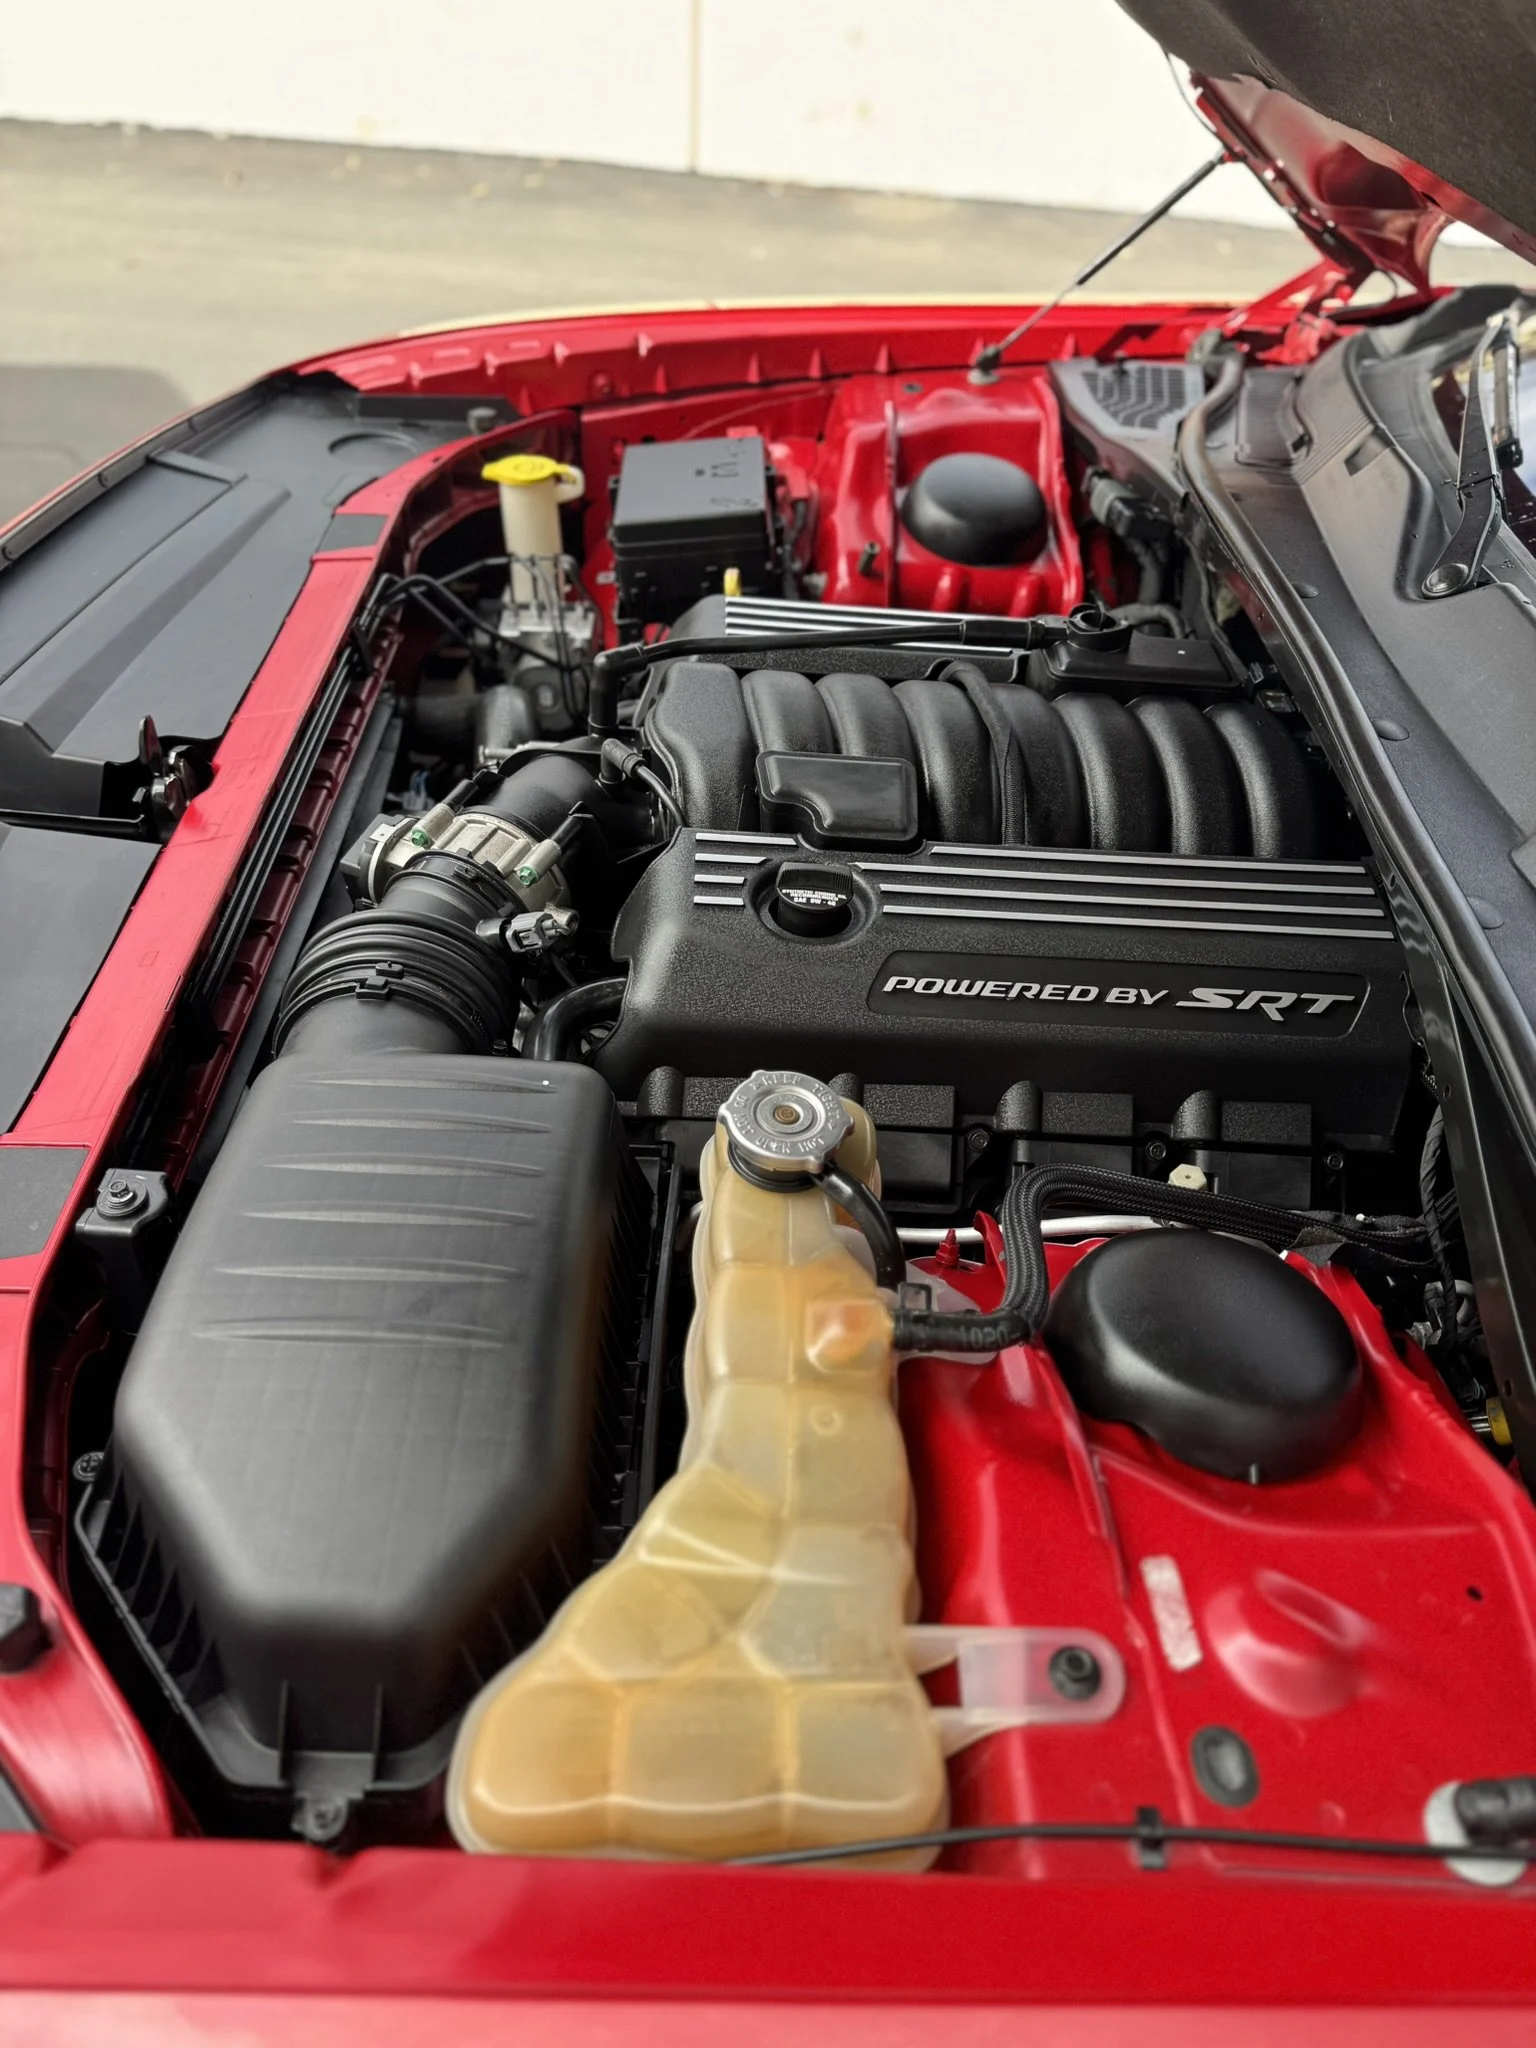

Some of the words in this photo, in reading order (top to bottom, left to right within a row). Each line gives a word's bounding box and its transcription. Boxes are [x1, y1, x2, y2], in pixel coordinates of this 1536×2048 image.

[883, 976, 1099, 1001] POWERED
[1105, 987, 1169, 1005] BY
[1176, 987, 1355, 1021] SRT
